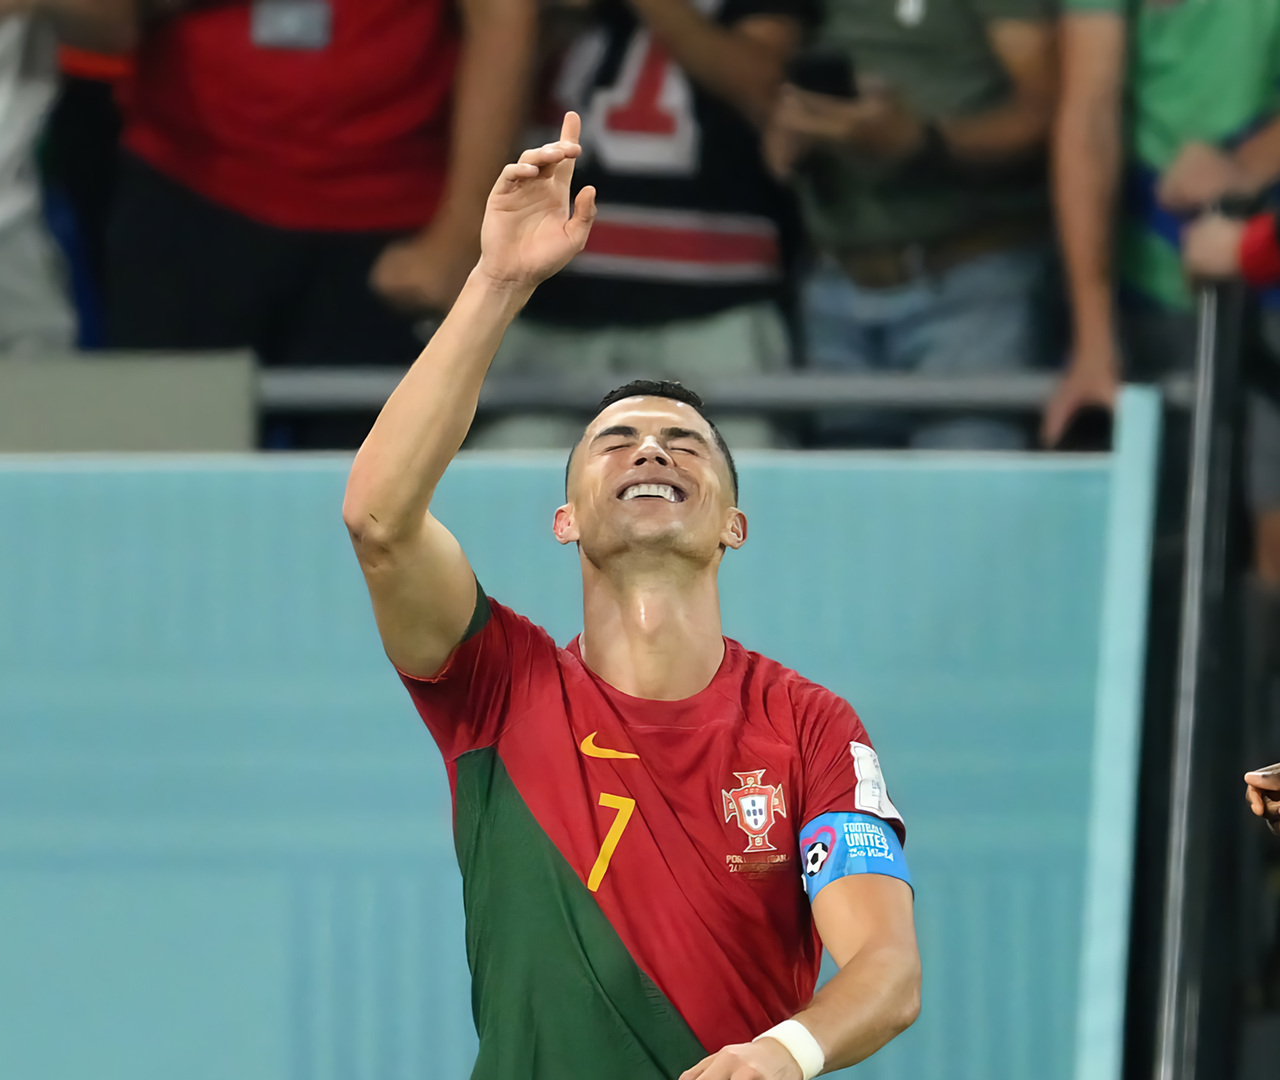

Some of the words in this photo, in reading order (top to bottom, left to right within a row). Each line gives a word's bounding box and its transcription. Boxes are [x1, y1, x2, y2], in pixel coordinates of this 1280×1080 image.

[843, 822, 885, 837] FOOTBALL
[586, 792, 636, 893] 7
[845, 833, 889, 850] UNITES
